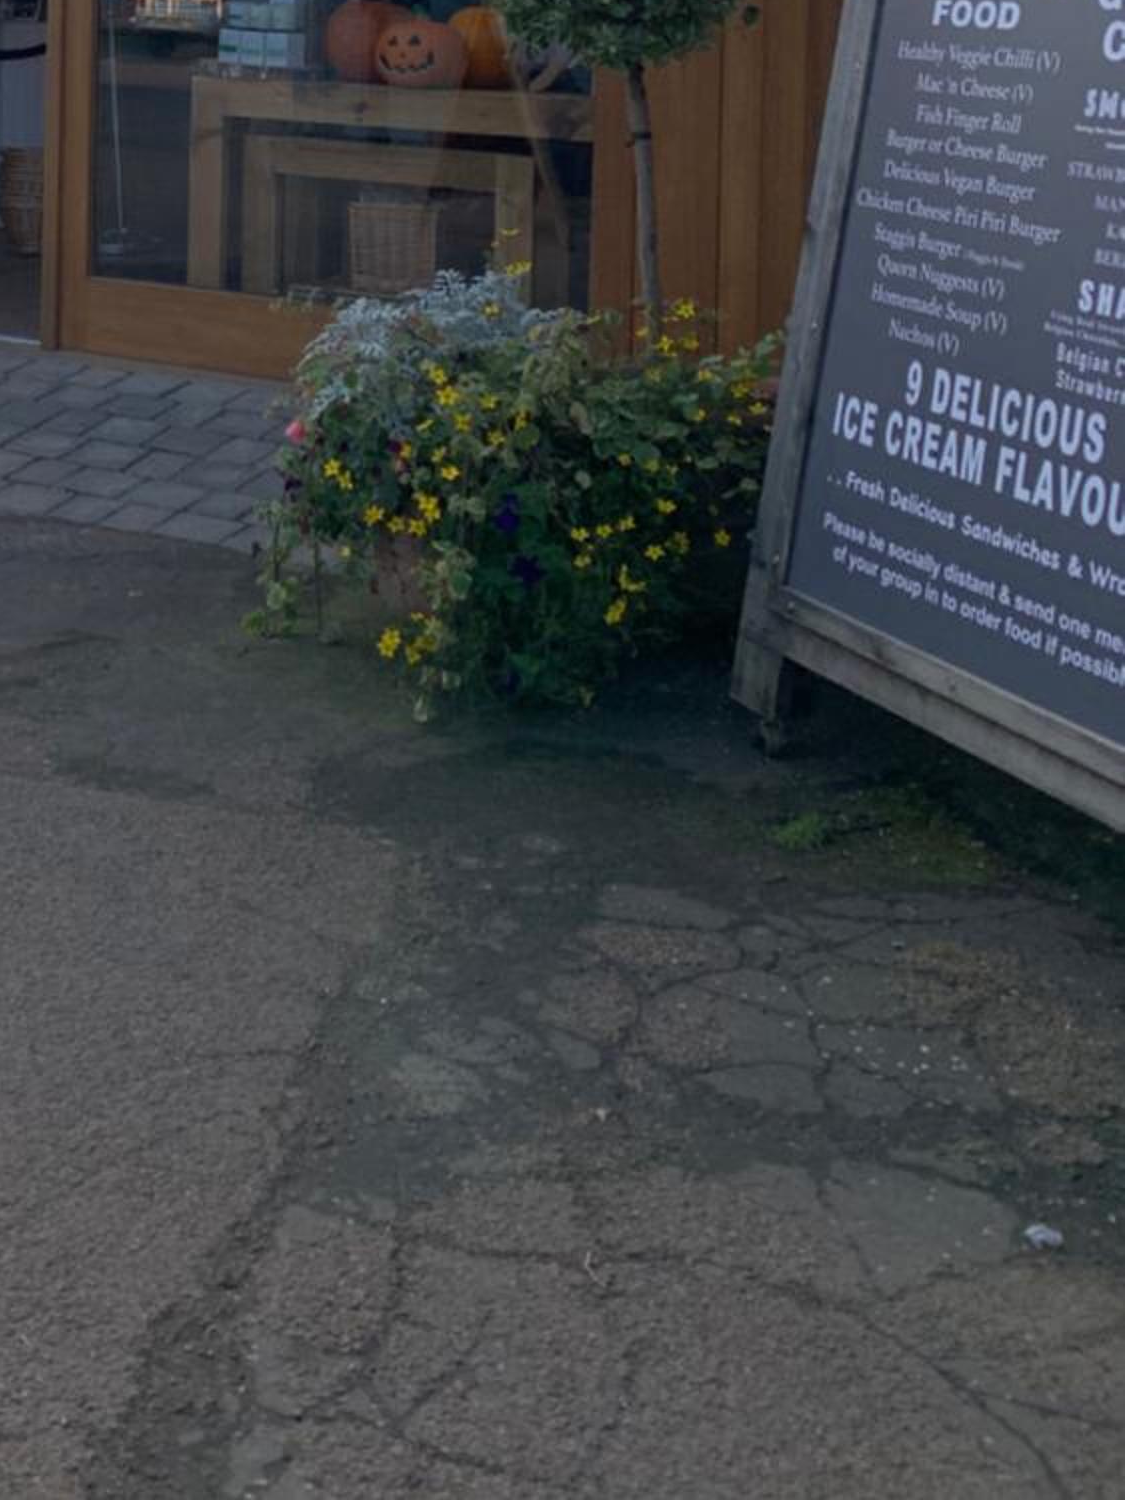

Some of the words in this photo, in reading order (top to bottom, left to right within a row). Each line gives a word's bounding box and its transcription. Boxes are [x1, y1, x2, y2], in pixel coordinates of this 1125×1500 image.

[897, 40, 946, 67] Healthy
[948, 44, 992, 70] Veggie
[993, 47, 1036, 70] Chilli
[1036, 51, 1062, 74] (V)
[915, 72, 944, 94] Mac
[960, 77, 1012, 100] Cheese
[1011, 84, 1034, 104] (V)
[1084, 88, 1125, 120] SM
[916, 103, 944, 126] Fish
[945, 107, 990, 135] Finger
[990, 111, 1023, 135] Roll
[885, 128, 929, 155] Burger
[930, 139, 944, 152] or
[944, 136, 995, 161] Cheese
[995, 143, 1048, 173] Burger
[883, 158, 941, 186] Delicious
[943, 167, 983, 196] Vegan
[985, 174, 1036, 204] Burger
[856, 187, 905, 214] Chicken
[906, 196, 953, 223] Cheese
[954, 205, 976, 228] Piri
[979, 209, 1008, 232] Piri
[1008, 214, 1062, 246] Burger
[917, 231, 962, 260] Burger
[877, 254, 918, 279] Quorn
[980, 277, 1006, 300] (V)
[871, 282, 945, 318] Homemade
[945, 300, 982, 332] Soup
[983, 310, 1008, 336] (V)
[889, 318, 936, 349] Nachos
[937, 331, 960, 357] (V)
[1056, 342, 1110, 373] Belgian
[905, 360, 923, 406] 9
[930, 367, 1107, 464] DELICIOUS
[833, 392, 878, 448] ICE
[885, 410, 987, 486] CREAM
[994, 446, 1125, 536] FLAVOU
[845, 470, 885, 502] Fresh
[889, 487, 956, 530] Delicious
[961, 515, 1061, 571] Sandwiches
[1066, 553, 1083, 579] &
[824, 512, 867, 543] Please
[867, 531, 886, 552] be
[888, 541, 942, 580] socially
[943, 565, 996, 600] distant
[997, 584, 1011, 606] &
[1014, 597, 1056, 625] send
[1058, 613, 1092, 639] one
[1095, 627, 1125, 657] me
[833, 546, 847, 564] of
[847, 553, 879, 575] your
[880, 566, 923, 599] group
[924, 581, 940, 603] in
[941, 592, 958, 613] to
[960, 601, 1002, 632] order
[1003, 616, 1044, 650] food
[1044, 634, 1058, 656] if
